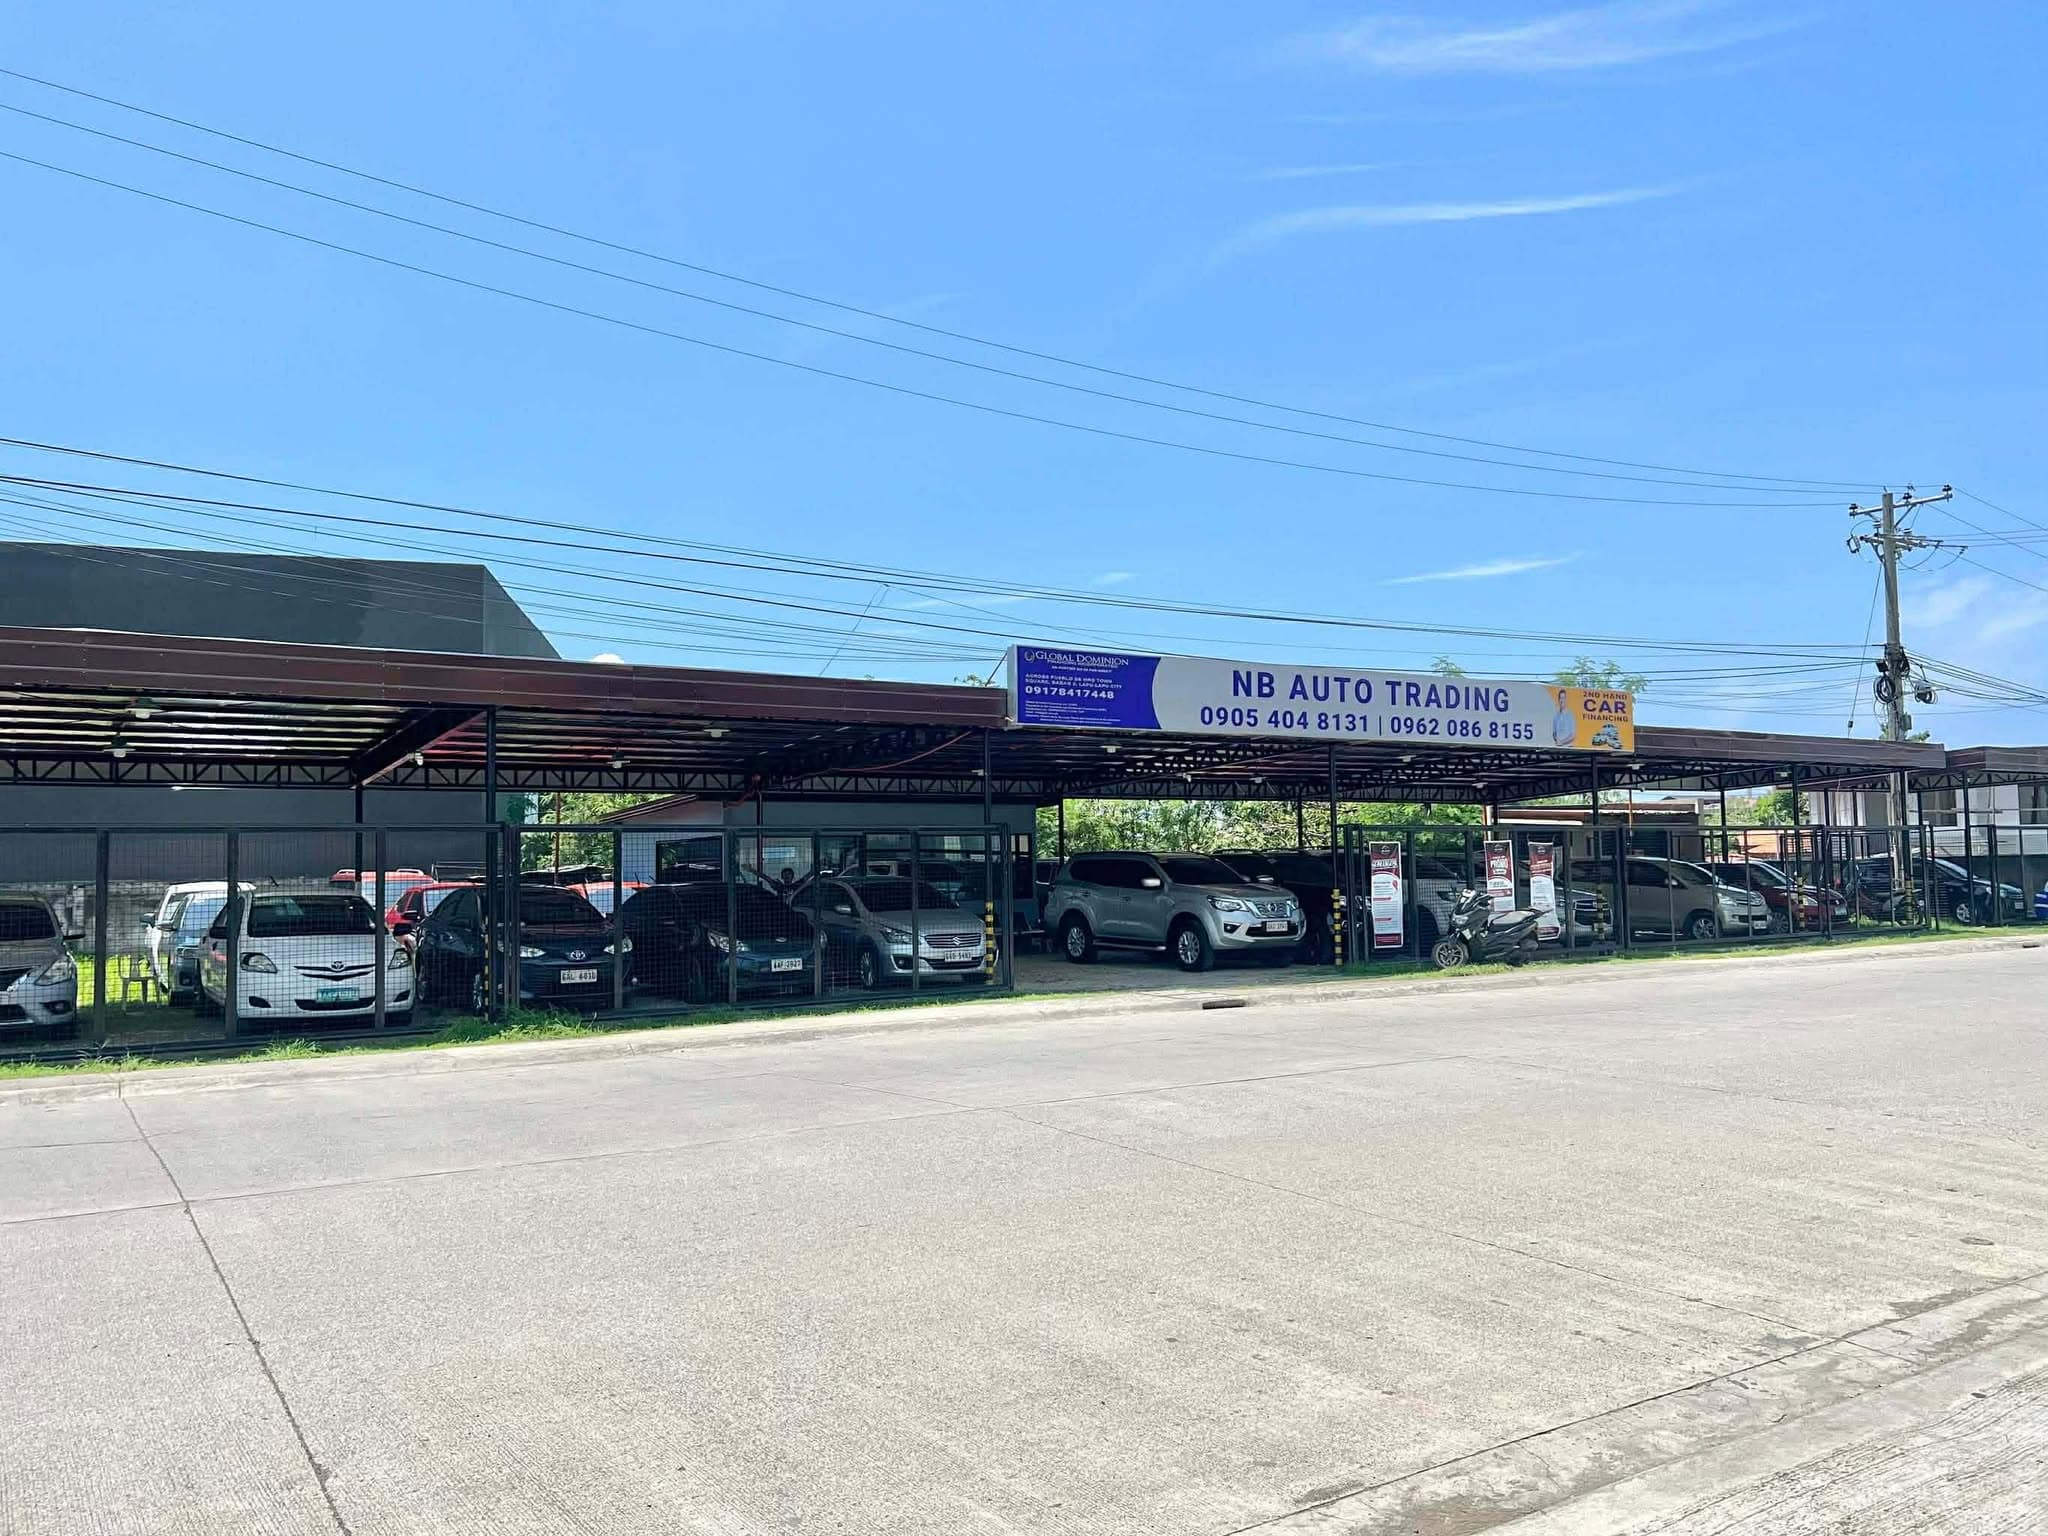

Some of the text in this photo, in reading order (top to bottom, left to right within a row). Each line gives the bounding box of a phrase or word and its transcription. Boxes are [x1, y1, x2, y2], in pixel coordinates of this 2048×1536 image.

[1035, 650, 1129, 666] GLOBAL DOMINION
[1025, 685, 1114, 699] 09178417448
[1233, 669, 1510, 713] NB AUTO TRADING
[1603, 692, 1628, 700] HAND
[1584, 698, 1627, 714] CAR
[1201, 705, 1534, 741] 0905 404 8131 0962 086 8155
[1582, 714, 1629, 722] FINANCING
